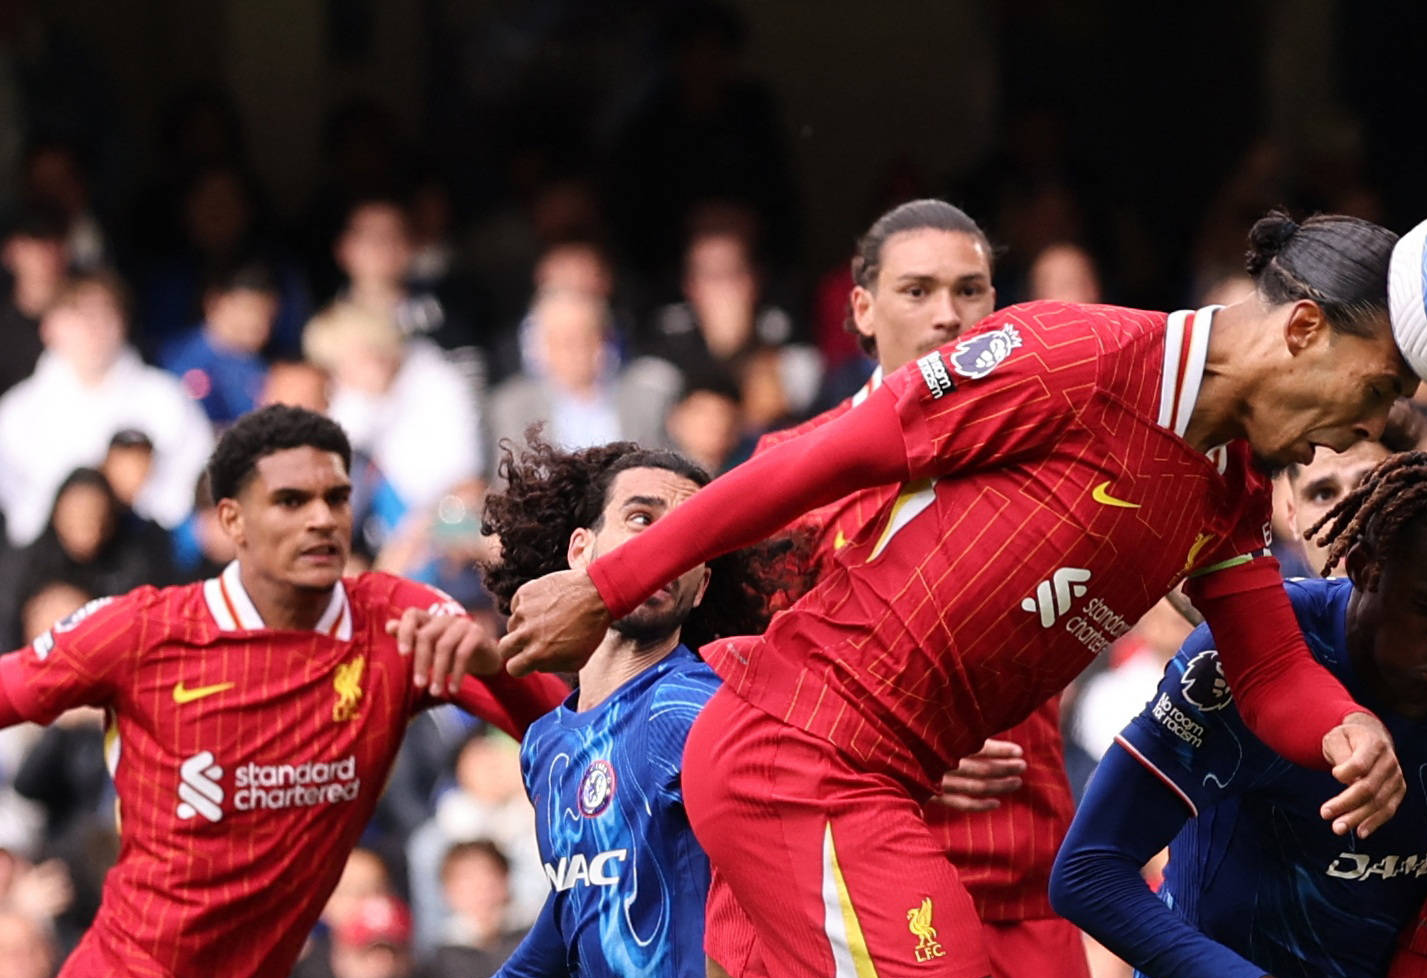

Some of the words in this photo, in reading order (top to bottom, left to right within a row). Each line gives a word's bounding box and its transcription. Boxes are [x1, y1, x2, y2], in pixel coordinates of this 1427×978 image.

[1162, 715, 1202, 748] racism
[1170, 707, 1204, 736] room
[235, 755, 356, 787] standard
[234, 778, 361, 810] chartered
